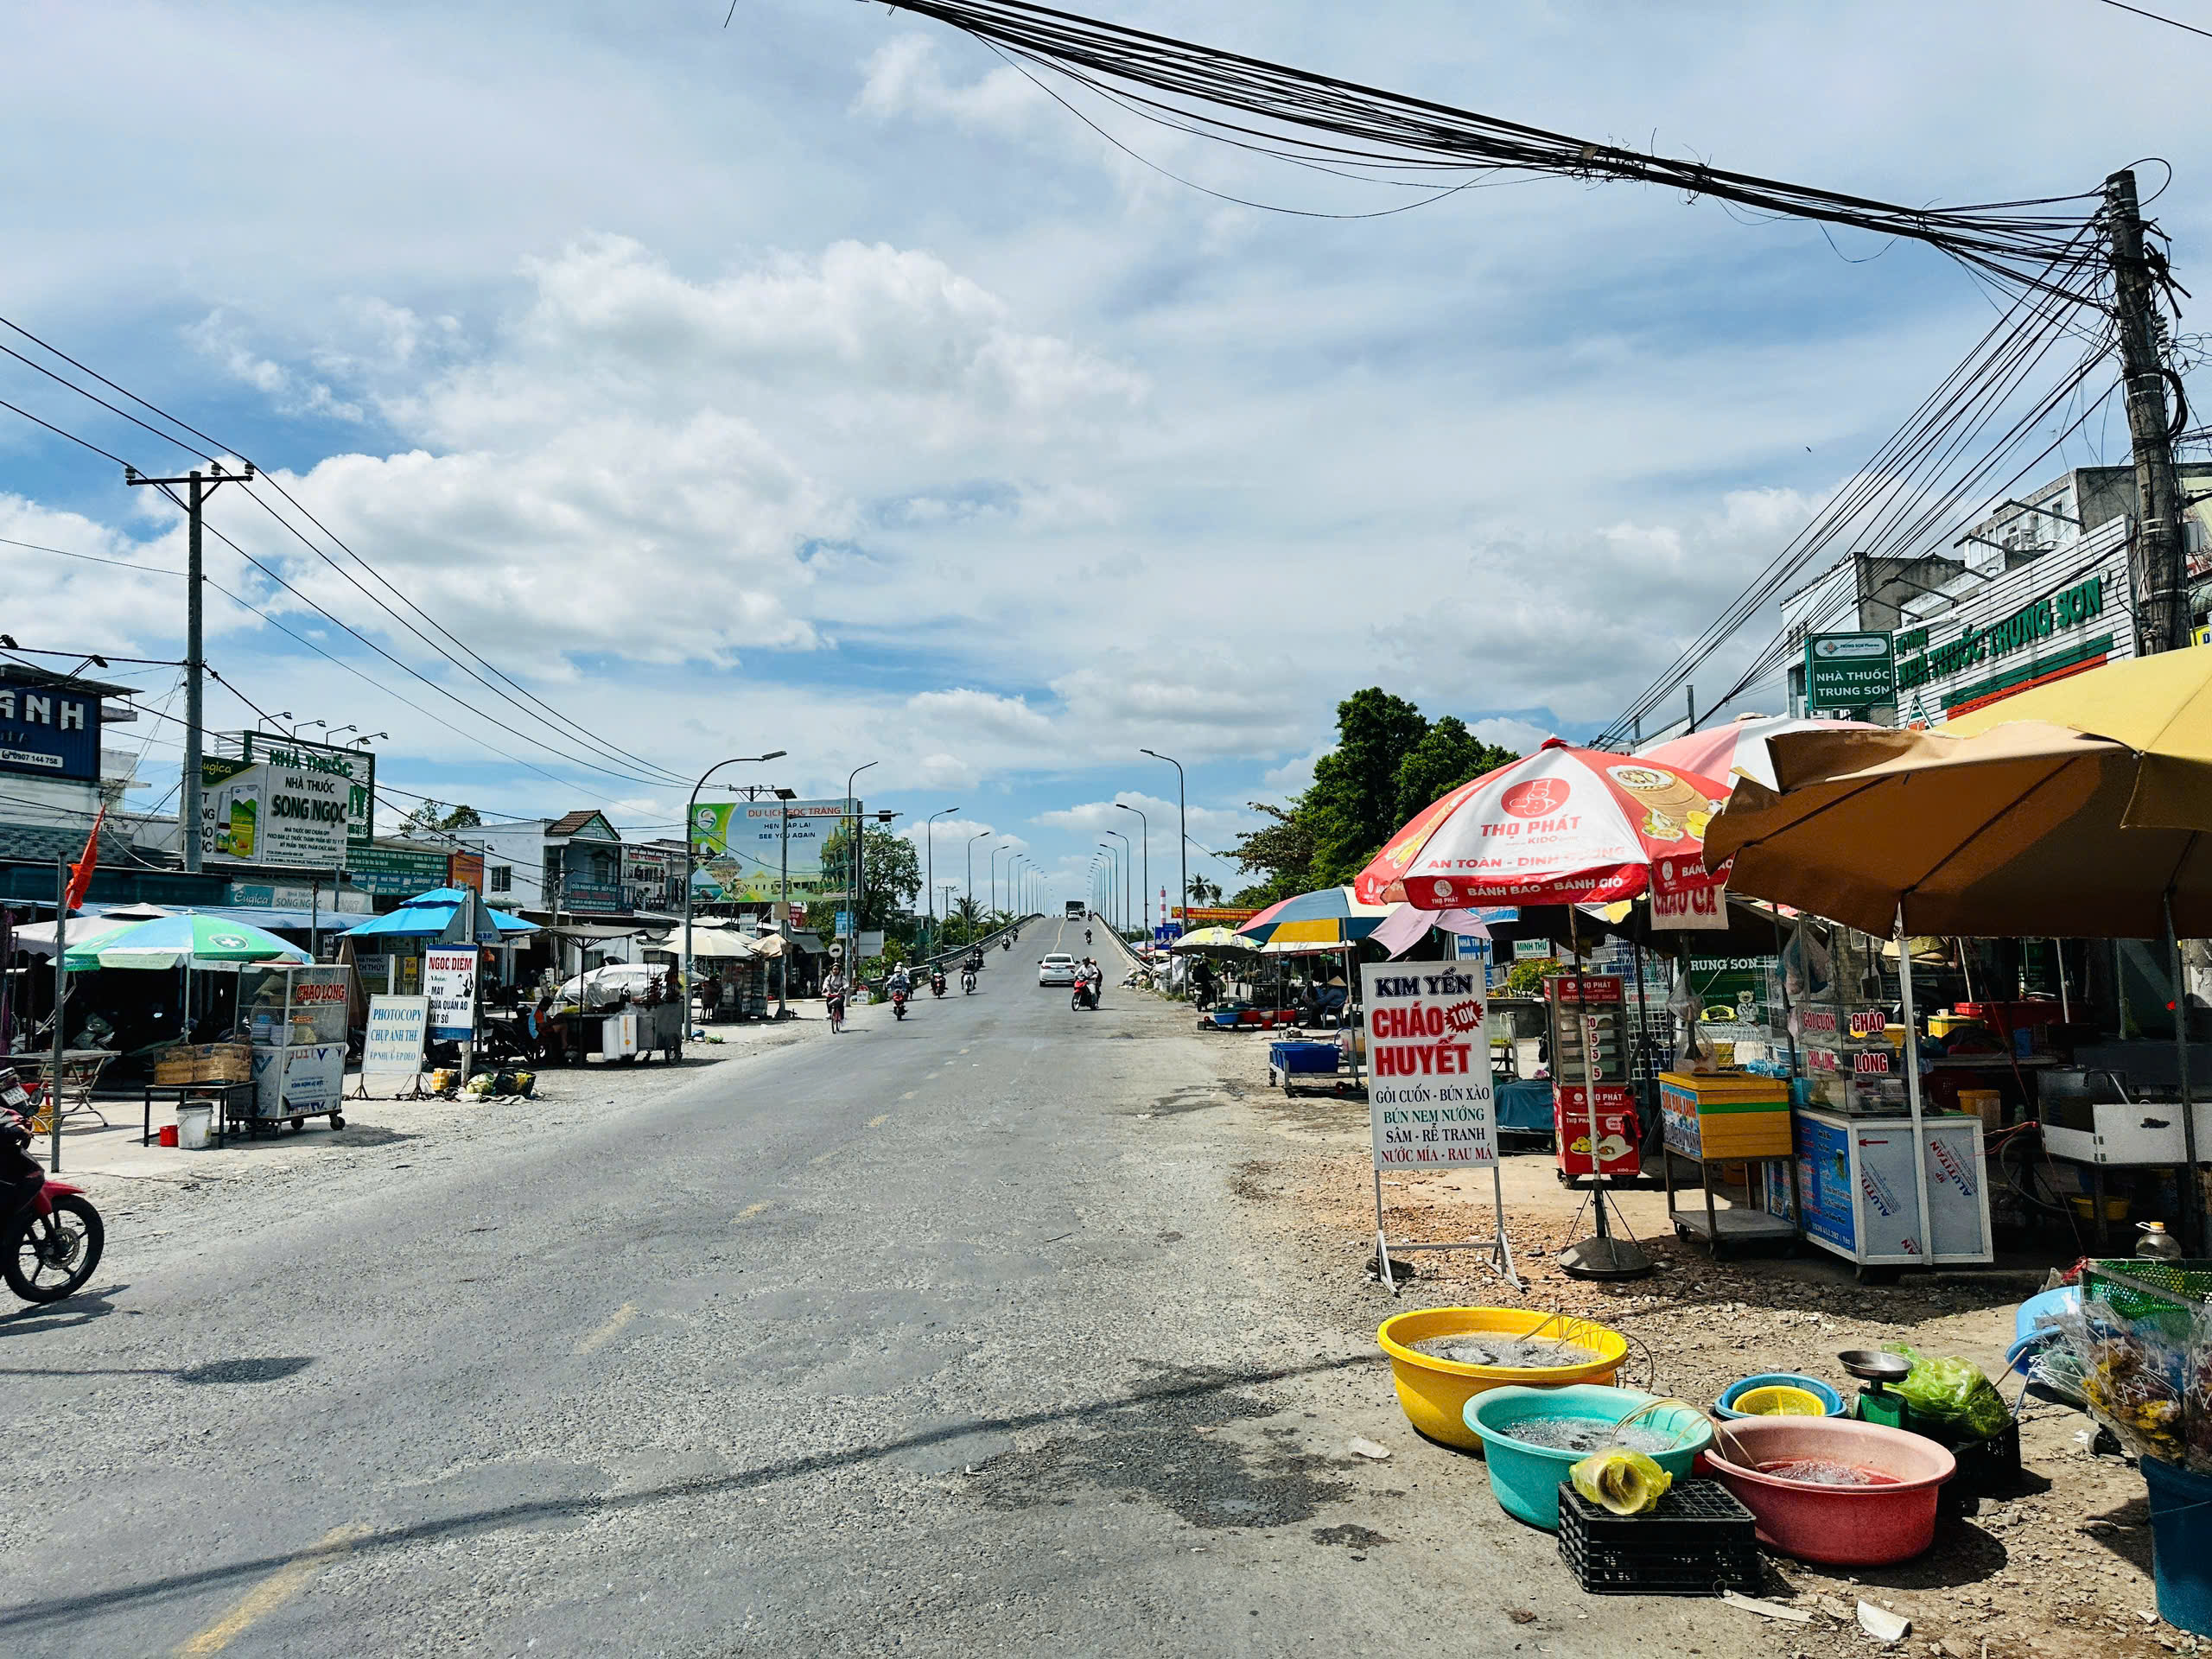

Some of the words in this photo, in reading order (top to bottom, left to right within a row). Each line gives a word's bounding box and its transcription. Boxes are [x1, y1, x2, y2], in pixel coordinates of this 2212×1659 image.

[1988, 600, 2055, 657] TRUNG
[2056, 574, 2104, 629] SƠN
[1816, 670, 1843, 682] NHÀ
[1847, 667, 1890, 681] THUỐC
[1817, 687, 1860, 696] TRUNG
[1864, 684, 1890, 696] SƠN
[200, 761, 232, 775] ugica
[285, 776, 304, 790] NHÀ
[307, 779, 335, 794] THUỐC
[271, 794, 309, 820] SONG
[311, 799, 347, 829] NGỌC
[748, 809, 762, 817] DU
[1480, 823, 1520, 839] THỌ
[1528, 814, 1582, 835] PHÁT
[1528, 836, 1558, 844] KIDO
[1427, 859, 1452, 868] AN
[1457, 856, 1502, 868] TOÀN
[1517, 856, 1559, 868] DINH
[1681, 862, 1707, 877] BÁN
[1467, 884, 1507, 897] BÁNH
[1510, 883, 1541, 894] BAO
[1554, 876, 1595, 891] BÁNH
[1599, 874, 1623, 888] GIÒ
[234, 890, 269, 906] Eugica
[276, 897, 298, 908] SONG
[1444, 895, 1459, 904] PHÁT
[1459, 938, 1471, 947] NHÀ
[1516, 942, 1534, 951] MINH
[1688, 959, 1727, 971] RUNG
[1374, 975, 1421, 997] KIM
[1423, 966, 1473, 995] YẾN
[431, 986, 444, 995] MAY
[372, 1008, 423, 1021] PHOTOCOPY
[1370, 1000, 1445, 1039] CHÁO
[1451, 1006, 1478, 1027] 10K
[1851, 1008, 1885, 1033] CHÁO
[371, 1028, 390, 1044] CHỤP
[1592, 1033, 1598, 1044] 5
[1373, 1033, 1472, 1077] HUYẾT
[1592, 1049, 1599, 1059] 5
[1853, 1048, 1888, 1074] LÒNG
[1593, 1067, 1600, 1078] 5
[1376, 1086, 1396, 1104] GỎI
[1399, 1084, 1430, 1103] CUỐN
[1440, 1084, 1463, 1102] BÚN
[1465, 1083, 1490, 1100] XÀO
[1603, 1091, 1623, 1102] PHÁT
[1383, 1109, 1408, 1124] BÚN
[1412, 1109, 1439, 1123] NEM
[1441, 1107, 1485, 1122] NƯỚNG
[1386, 1126, 1412, 1144] SÂM
[1422, 1122, 1439, 1142] RỄ
[1443, 1127, 1485, 1142] TRANH
[1381, 1147, 1414, 1164] NƯỚC
[1416, 1145, 1439, 1162] MÍA
[1447, 1147, 1471, 1161] RAU
[1475, 1142, 1493, 1160] MÁ
[1929, 1140, 1973, 1198] ALUTITAN
